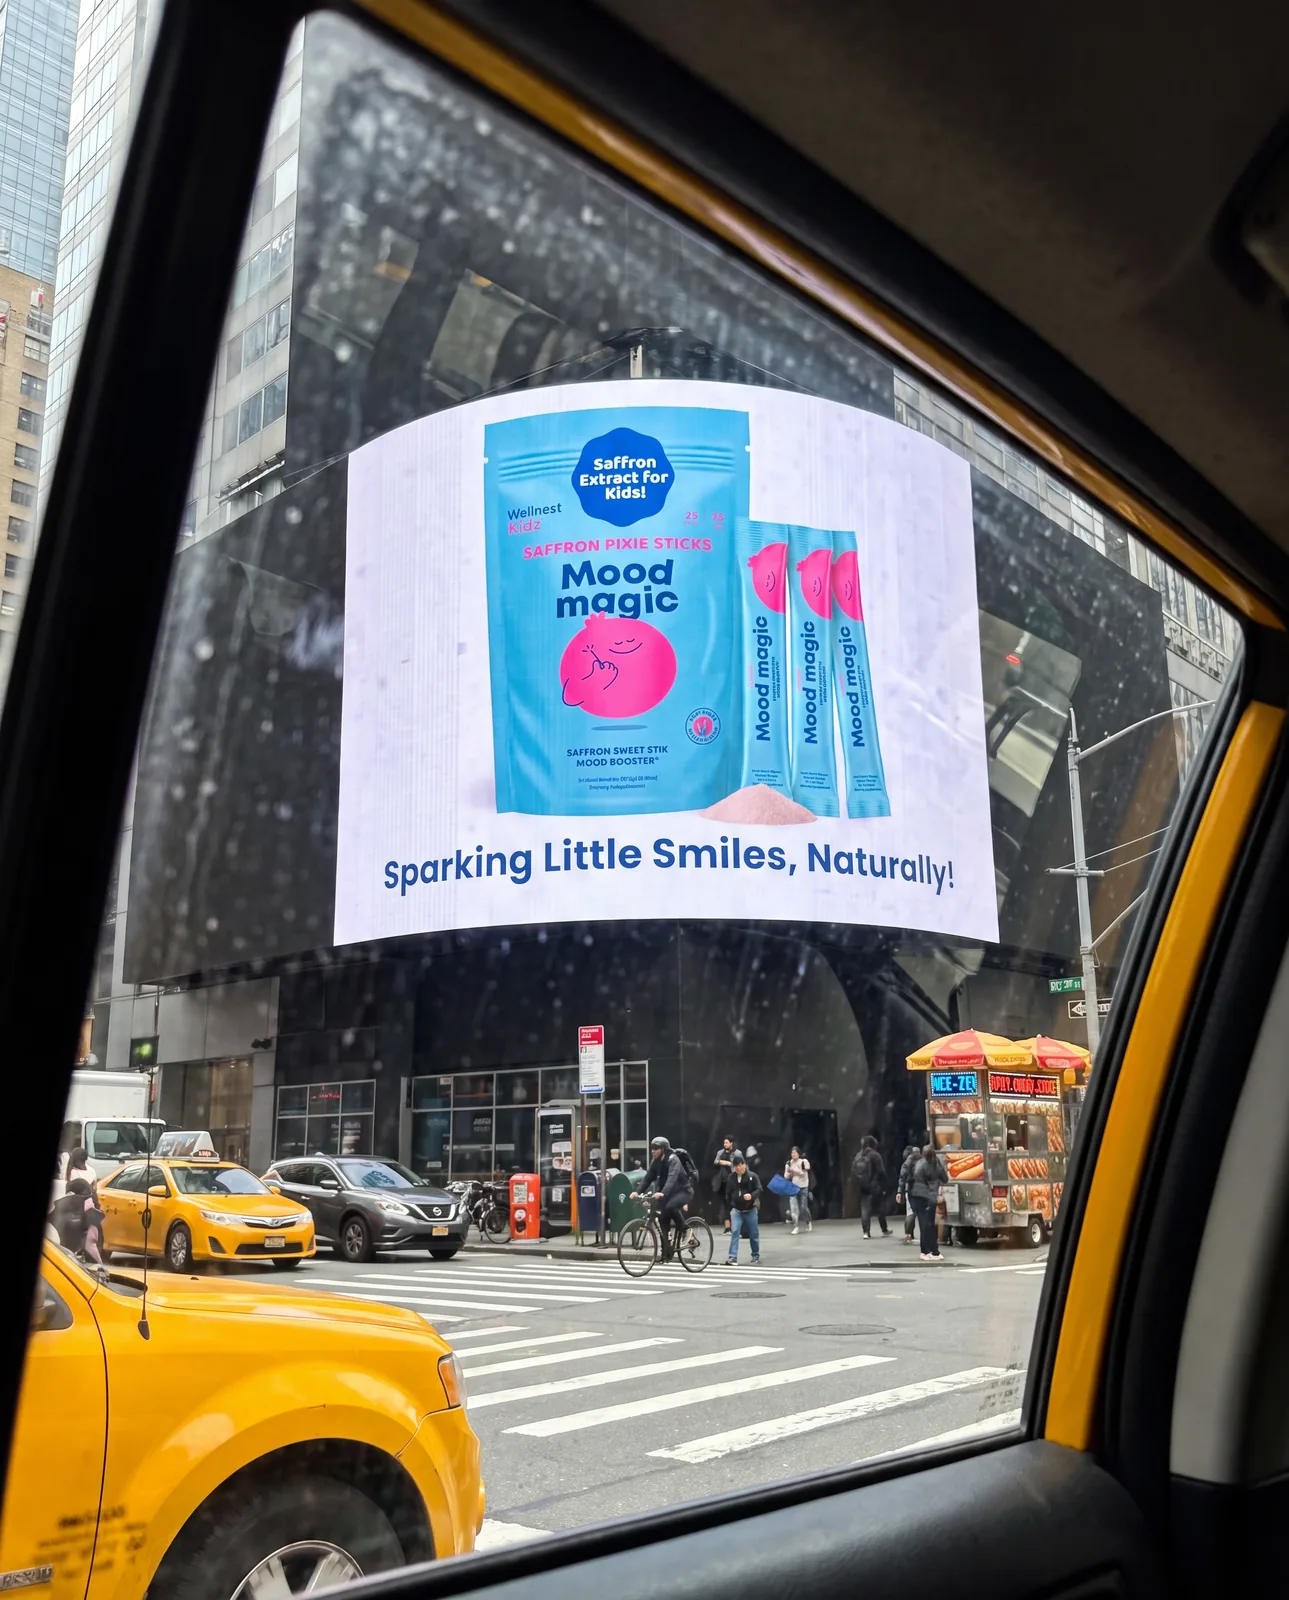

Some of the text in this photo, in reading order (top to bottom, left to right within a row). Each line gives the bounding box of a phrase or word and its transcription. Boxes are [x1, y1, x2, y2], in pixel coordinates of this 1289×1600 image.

[593, 455, 657, 471] Saffron
[579, 471, 669, 487] Extract for
[605, 486, 646, 500] Kids!
[507, 502, 562, 520] Wellnest
[685, 511, 698, 520] 25
[507, 518, 541, 535] Kidz
[523, 537, 712, 560] SAFFRON PIXIE STICKS
[561, 559, 674, 590] Mood
[556, 585, 679, 620] magic
[838, 626, 857, 687] magic
[753, 616, 773, 741] Mood magic
[800, 621, 820, 744] Mood magic
[846, 691, 865, 747] Mood
[566, 745, 668, 757] SAFFRON SWEET STIK
[576, 759, 607, 767] MOOD
[384, 835, 955, 897] Sparking Little Smiles, Naturally!
